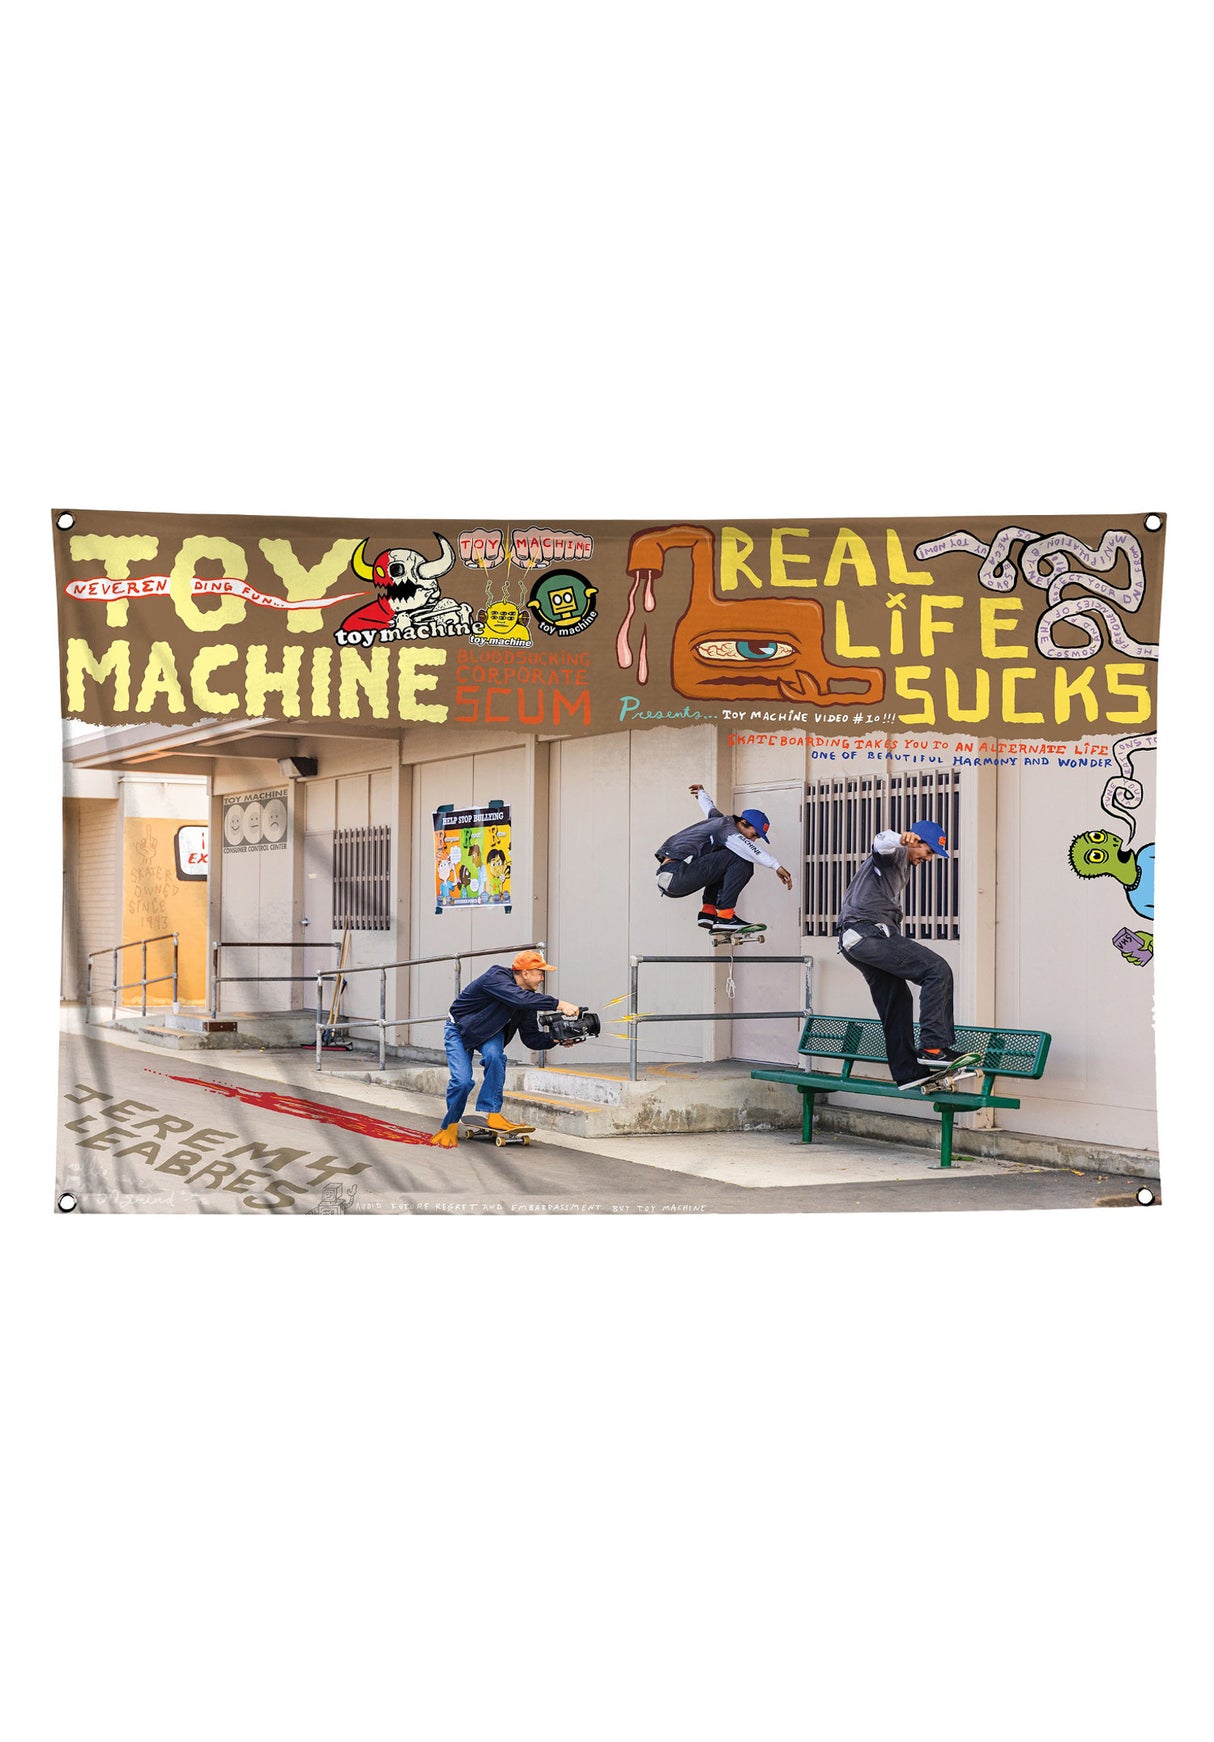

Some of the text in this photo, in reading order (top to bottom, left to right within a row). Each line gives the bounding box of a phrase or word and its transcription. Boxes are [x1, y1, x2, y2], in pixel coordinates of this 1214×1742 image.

[461, 538, 591, 551] TOY MACHINE
[1047, 535, 1127, 567] MANIPULATION
[720, 526, 934, 591] REAL
[1129, 545, 1142, 572] FROM
[69, 534, 366, 633] TOY
[1088, 579, 1116, 598] YOUR
[1122, 581, 1143, 604] DNA
[539, 611, 597, 636] toy machine
[1055, 606, 1070, 619] OF
[335, 620, 484, 648] toy machine
[488, 636, 532, 648] machine
[1040, 620, 1051, 644] THE
[67, 638, 449, 723] MACHINE
[456, 665, 589, 686] CORPORATE
[895, 663, 1151, 725] SUCKS
[455, 685, 591, 726] SCUM
[722, 709, 747, 720] TOY
[814, 712, 850, 723] VIDEO
[727, 733, 850, 750] SKATEBOARDING
[854, 739, 898, 750] TAKES
[904, 739, 928, 750] YOU
[932, 740, 949, 750] TO
[955, 742, 974, 753] AN
[979, 742, 1067, 755] ALTERNATE
[811, 751, 1113, 769] ONE OF BEAUTIFUL HARMONY AND WONDER
[224, 789, 288, 804] TOY MACHINE
[442, 811, 504, 826] HELP STOP BULLYING
[130, 866, 172, 883] SKATER
[135, 883, 179, 899] OWNED
[1117, 934, 1132, 949] VHS
[63, 1084, 373, 1186] JEREMY
[64, 1115, 309, 1209] LEABRES
[356, 1202, 382, 1210] AVOID
[435, 1202, 475, 1211] REGRET
[482, 1203, 503, 1211] AND
[662, 1204, 707, 1212] MACHINE
